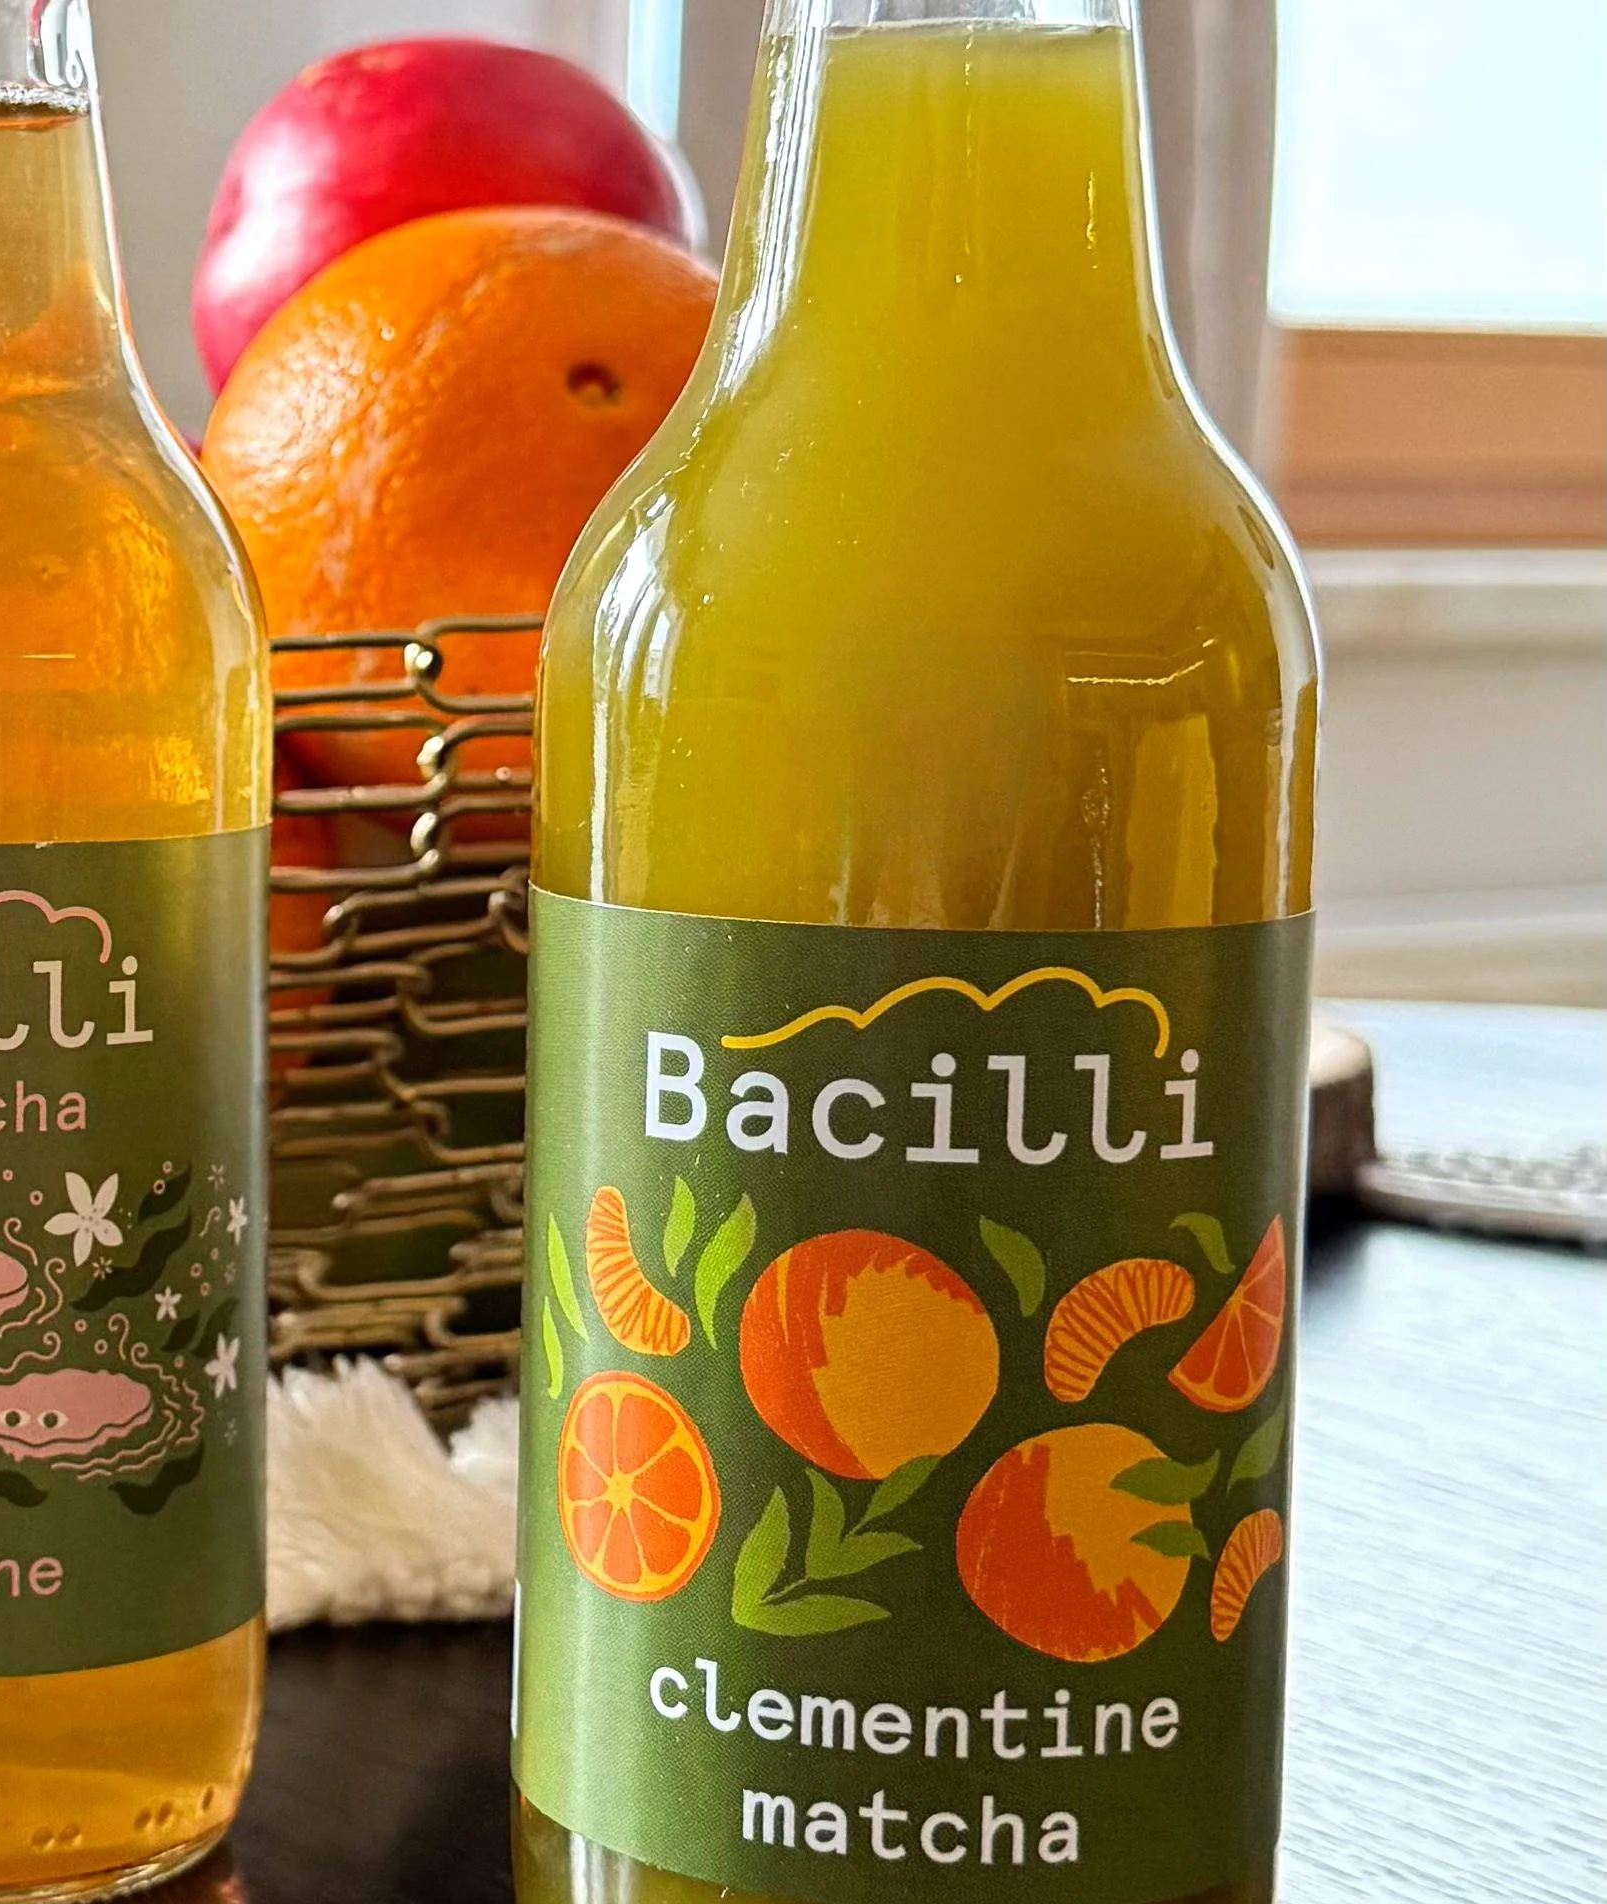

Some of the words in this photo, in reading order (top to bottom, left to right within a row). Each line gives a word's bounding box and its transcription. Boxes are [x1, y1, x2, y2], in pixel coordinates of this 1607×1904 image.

[644, 1030, 1215, 1165] Bacilli
[649, 1657, 1180, 1760] clementine
[741, 1788, 1080, 1865] matcha
